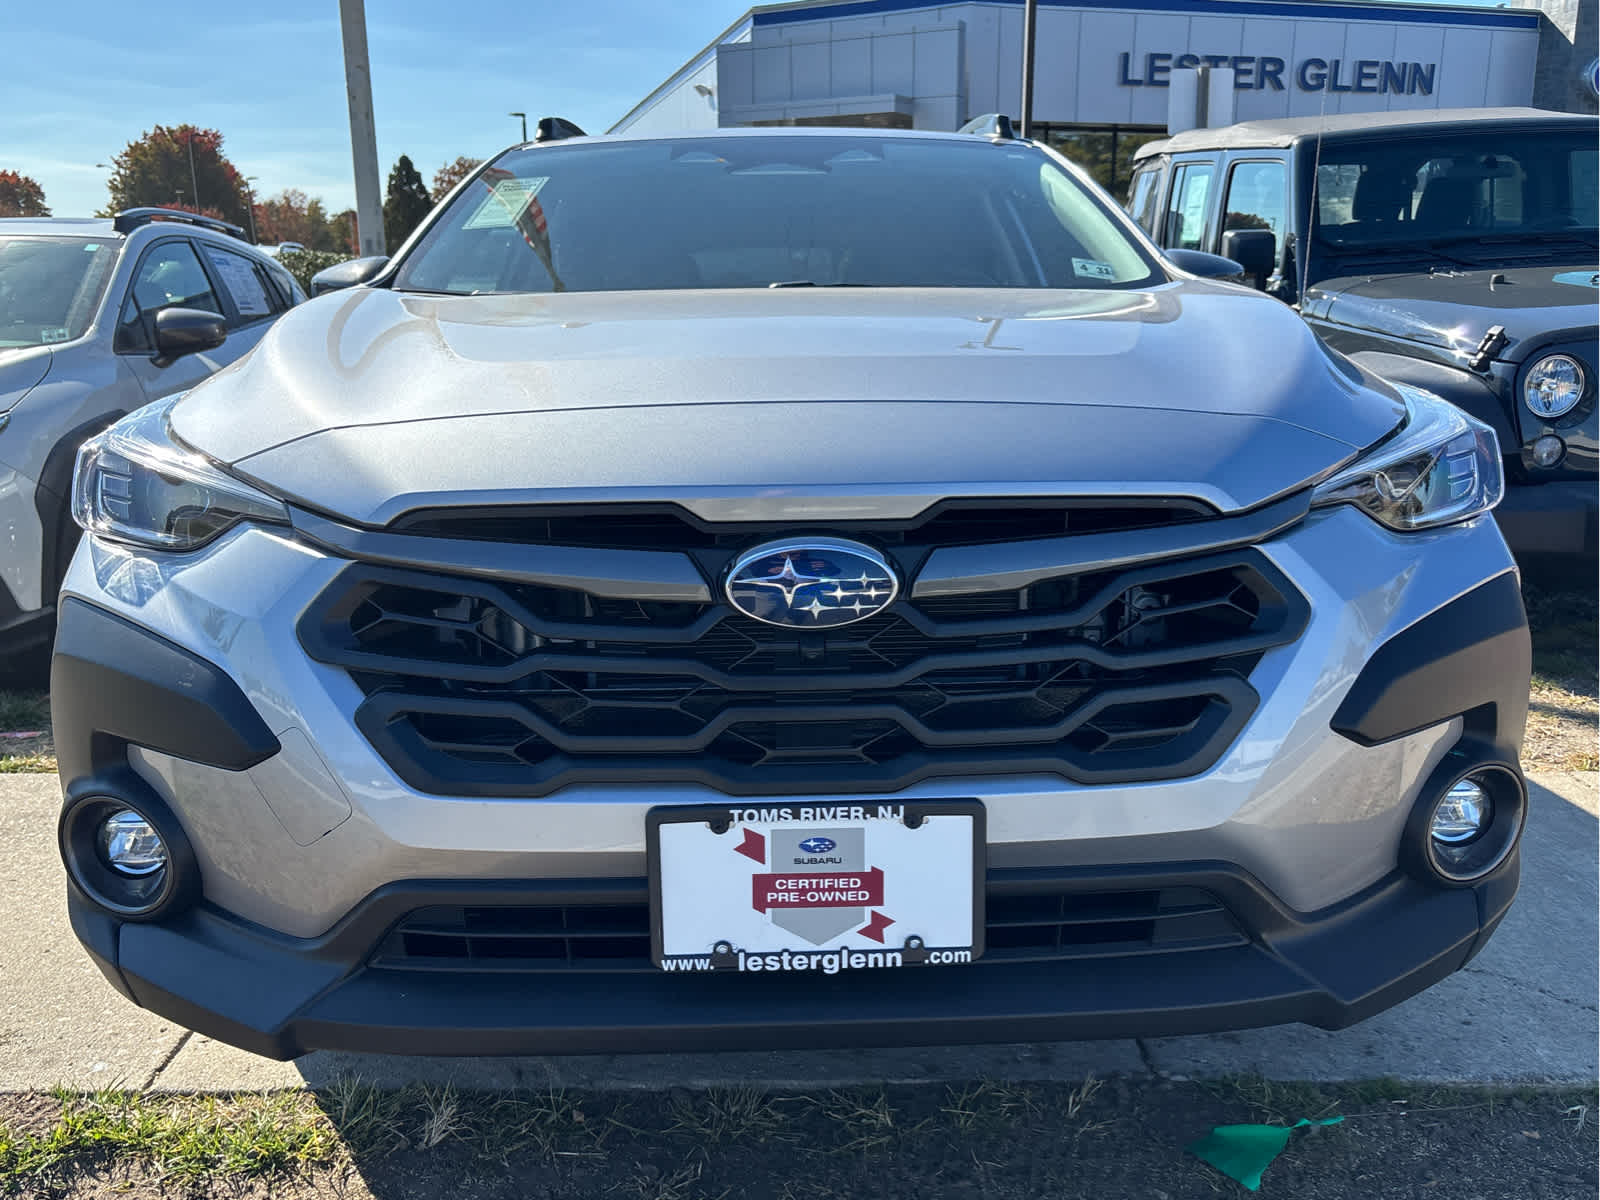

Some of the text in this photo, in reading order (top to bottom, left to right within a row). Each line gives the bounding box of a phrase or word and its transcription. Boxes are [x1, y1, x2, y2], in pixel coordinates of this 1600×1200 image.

[1296, 57, 1437, 96] GLENN
[729, 808, 795, 824] TOMS
[877, 805, 905, 821] NJ
[793, 857, 842, 865] SUBARU
[775, 878, 861, 889] CERTIFIED
[767, 891, 870, 903] PRE-OWNED
[661, 950, 971, 974] www. lesterglenn .com
